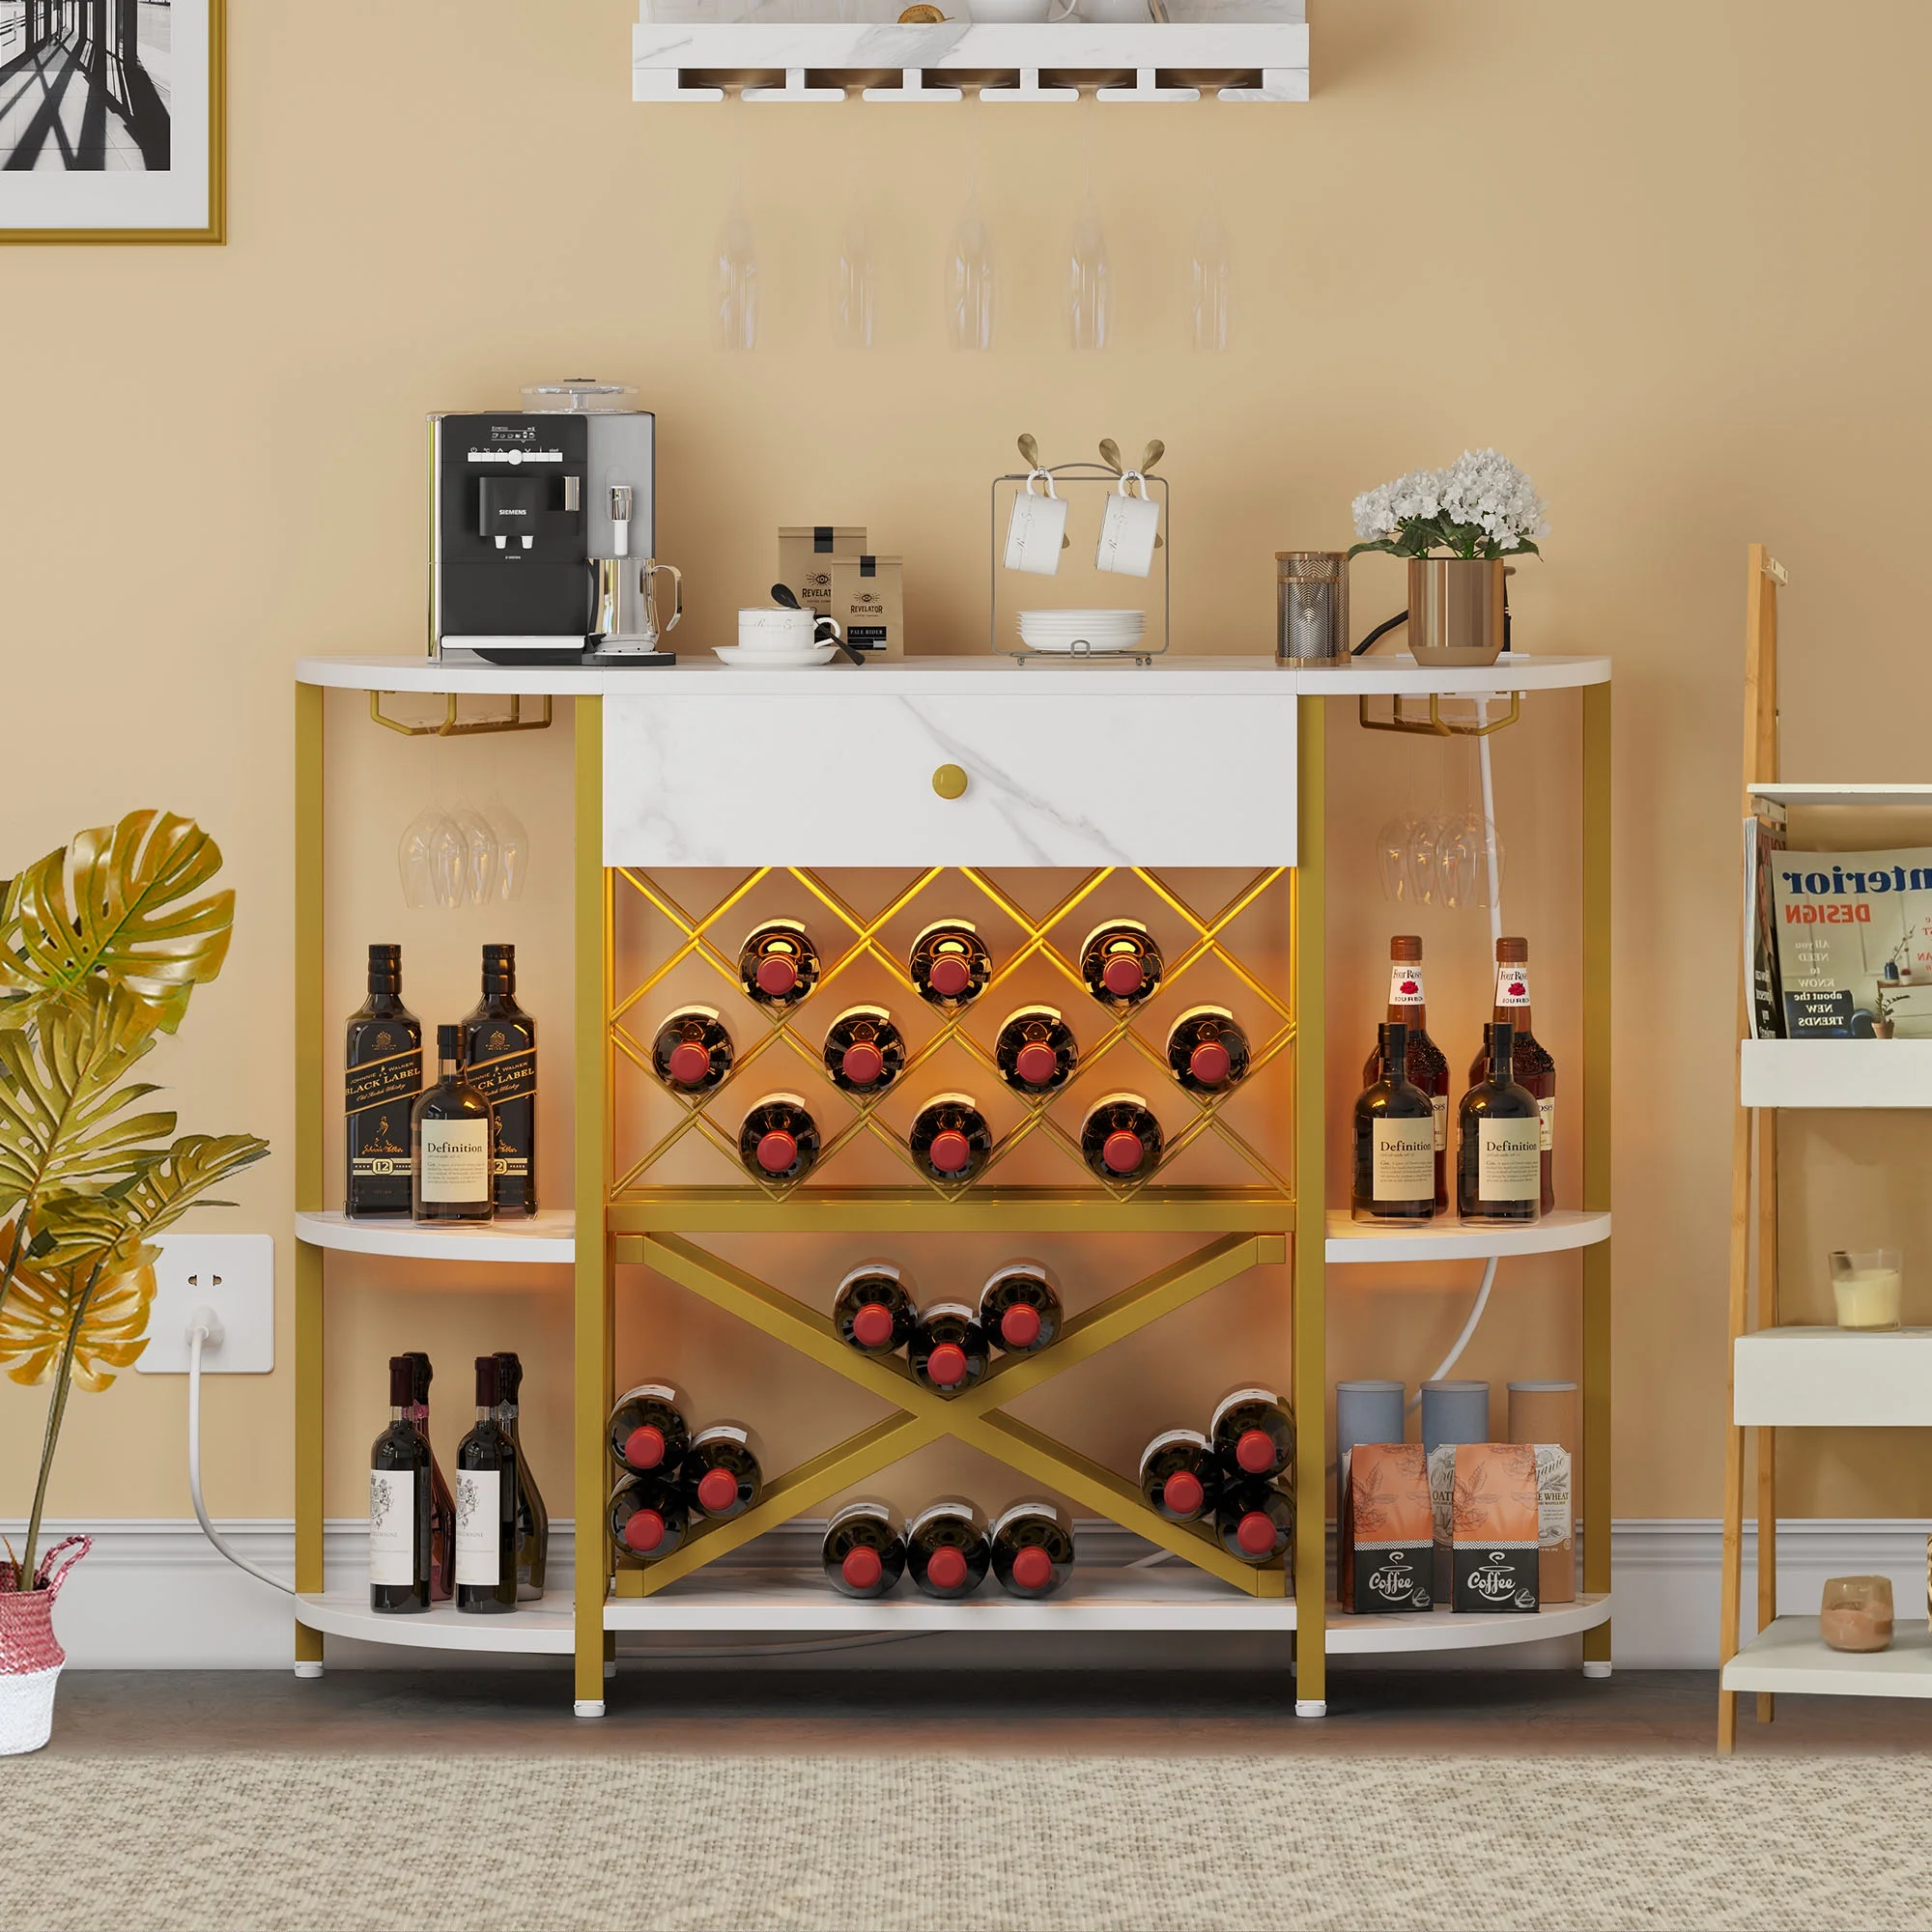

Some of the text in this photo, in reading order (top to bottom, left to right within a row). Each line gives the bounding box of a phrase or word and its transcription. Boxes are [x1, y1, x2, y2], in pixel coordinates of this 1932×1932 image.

[802, 588, 831, 599] REVELAT
[850, 605, 883, 614] REVELATOR
[388, 1062, 414, 1072] WALKER
[502, 1062, 528, 1072] WALKER
[497, 1067, 535, 1084] LABEL
[345, 1067, 421, 1096] BLACK LABEL
[427, 1142, 483, 1152] Definition
[1380, 1141, 1432, 1151] Definition
[1487, 1141, 1537, 1151] Definition
[377, 1162, 389, 1171] 12
[1544, 1492, 1569, 1501] WHEAT
[1369, 1572, 1413, 1594] Coffee
[1467, 1571, 1516, 1594] Coffee
